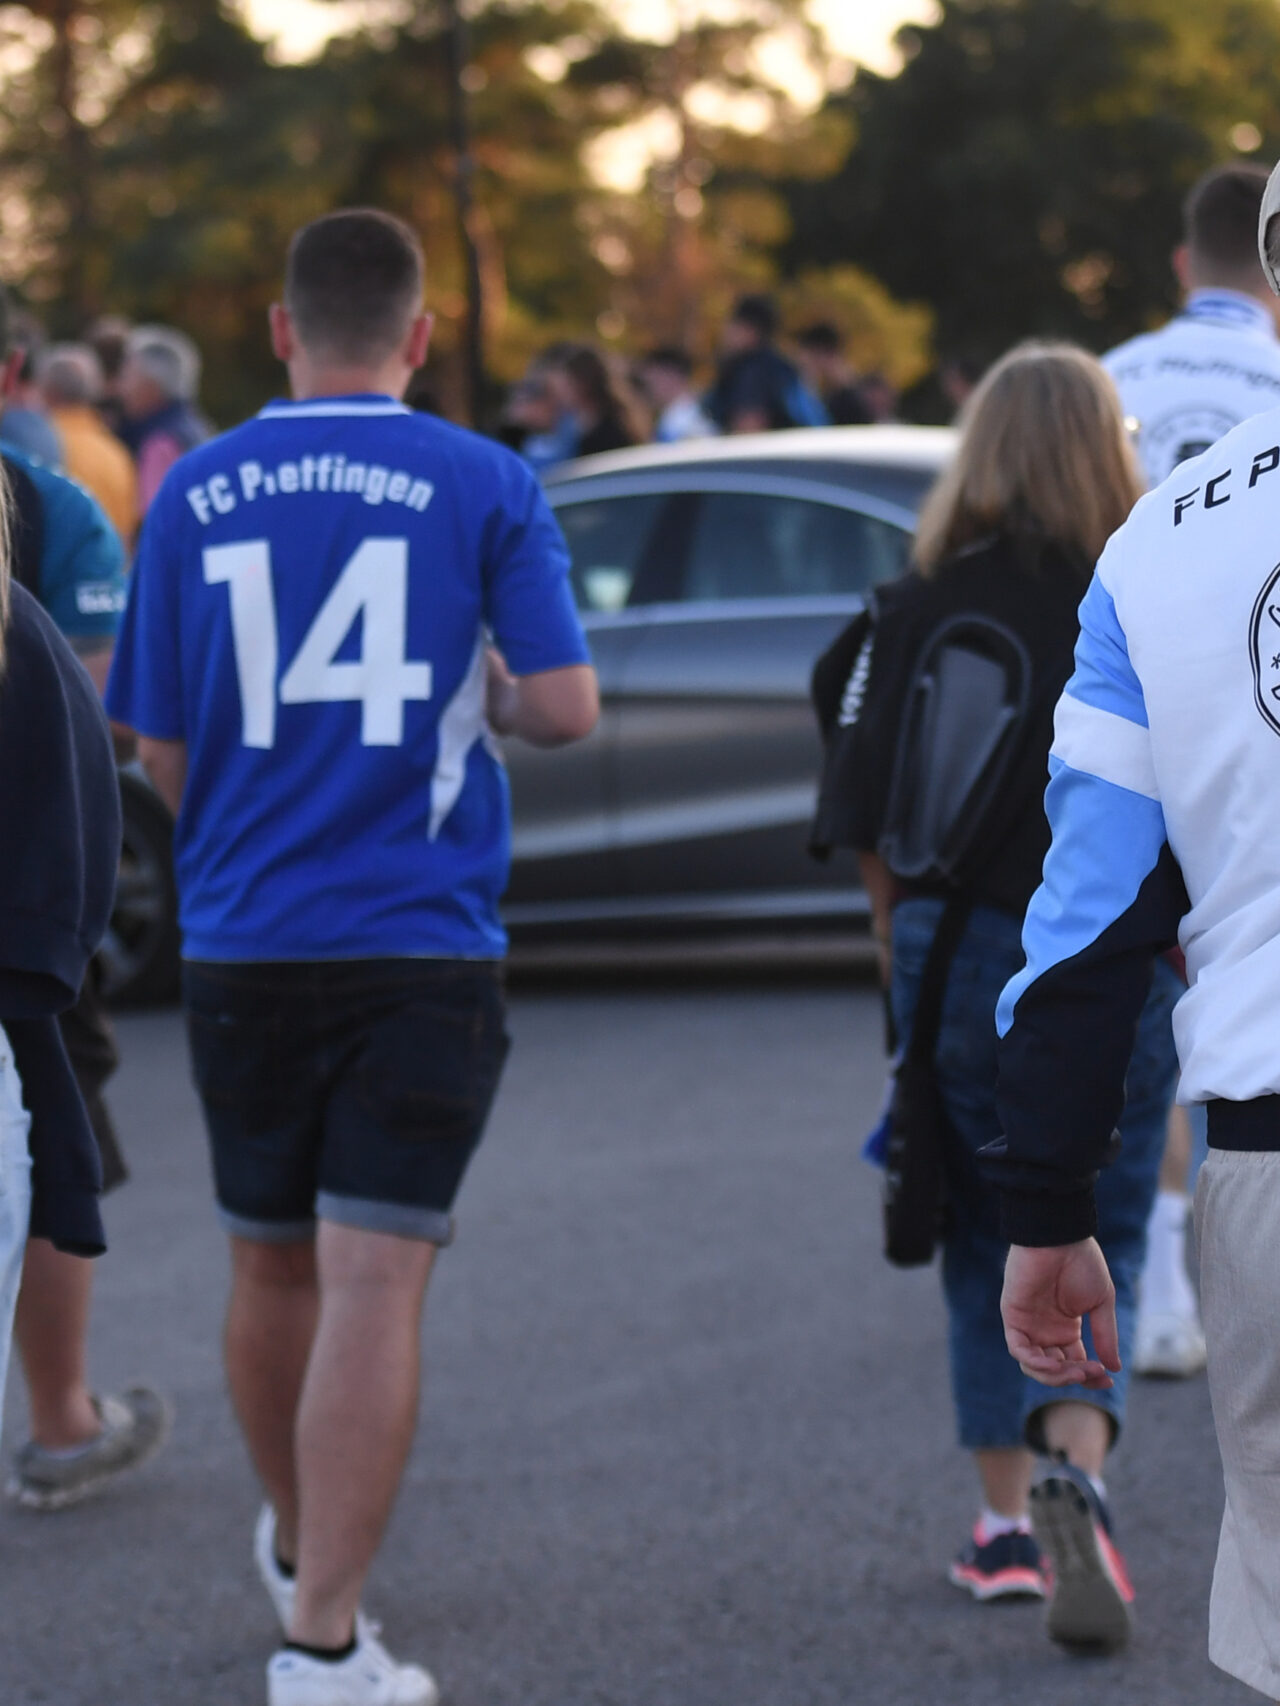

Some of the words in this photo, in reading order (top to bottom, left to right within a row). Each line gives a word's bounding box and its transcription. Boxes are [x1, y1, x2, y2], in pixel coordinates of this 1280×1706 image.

[186, 473, 236, 525] FC
[1174, 469, 1232, 527] FC
[203, 538, 432, 749] 14
